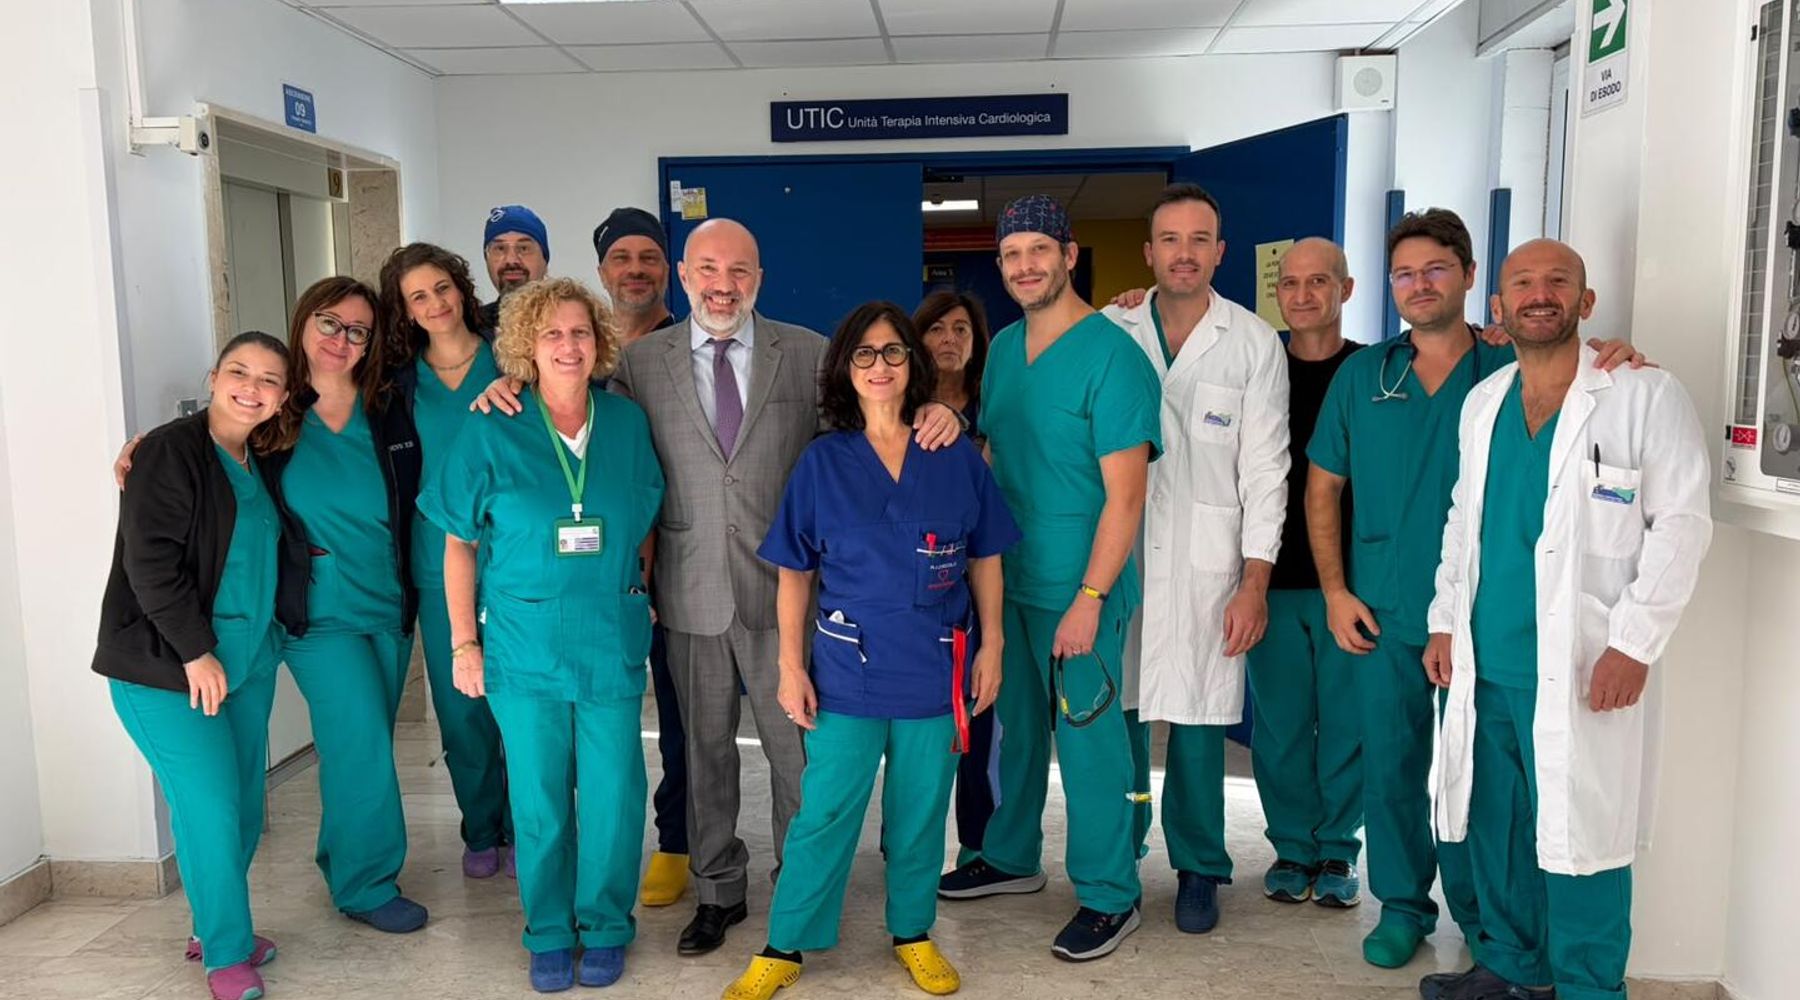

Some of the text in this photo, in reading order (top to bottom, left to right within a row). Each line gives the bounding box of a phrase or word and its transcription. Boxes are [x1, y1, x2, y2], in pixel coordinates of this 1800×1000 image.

[1601, 67, 1613, 81] VIA
[1590, 81, 1621, 102] DI ESODO
[294, 101, 306, 117] 09
[787, 107, 1052, 129] UTIC Unità Terapia Intensiva Cardiologica
